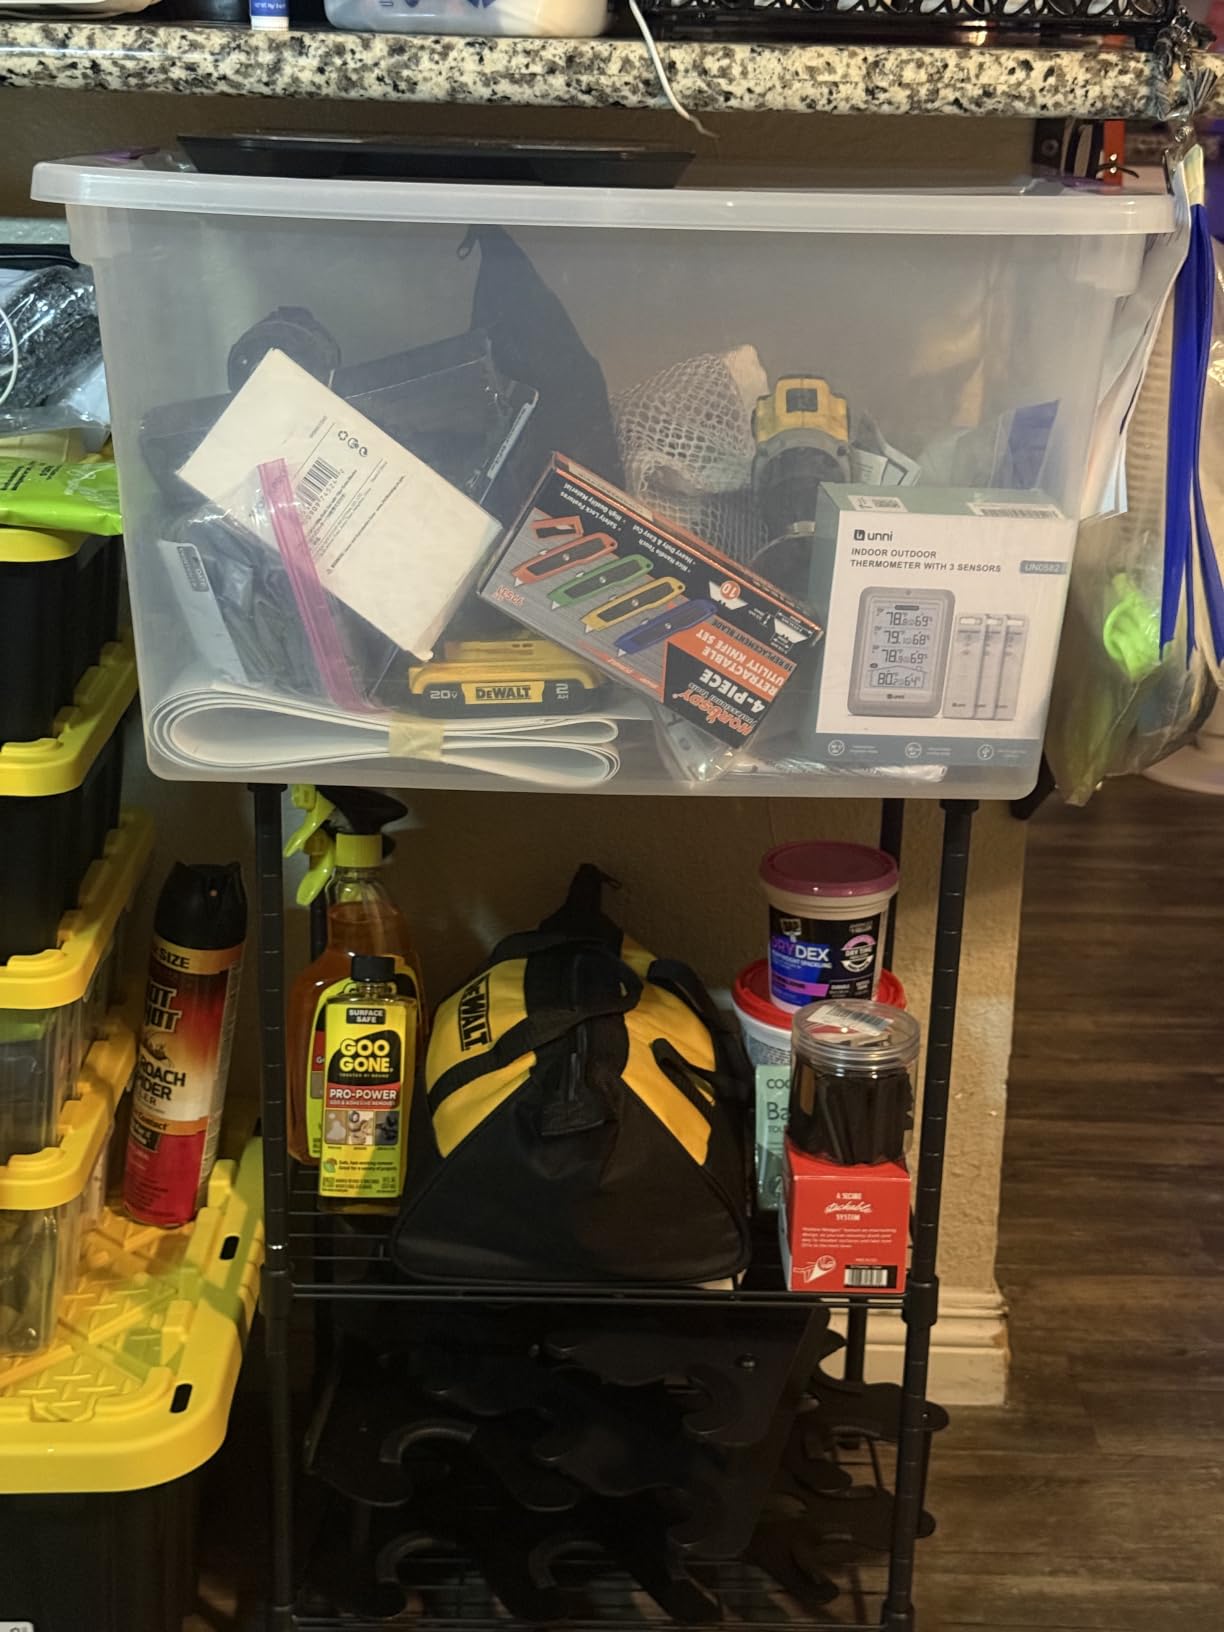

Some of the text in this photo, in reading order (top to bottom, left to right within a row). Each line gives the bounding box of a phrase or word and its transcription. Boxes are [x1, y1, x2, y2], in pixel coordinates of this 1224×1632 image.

[867, 530, 893, 542] unni
[851, 548, 937, 559] INDOOR OUTDOOR
[851, 559, 1001, 573] THERMOMETER WITH 3 SENSORS
[721, 582, 738, 598] 10
[695, 627, 716, 645] SET
[713, 638, 747, 663] KNIFE
[700, 645, 779, 697] RETRACTABLE
[744, 657, 786, 687] UTILITY
[555, 683, 569, 694] 2
[697, 667, 767, 715] 4-PIECE
[160, 948, 191, 969] SIZE
[348, 1009, 384, 1017] SURFACE
[340, 1038, 390, 1057] GOO
[339, 1056, 390, 1073] GONE
[329, 1089, 397, 1100] PRO-POWER
